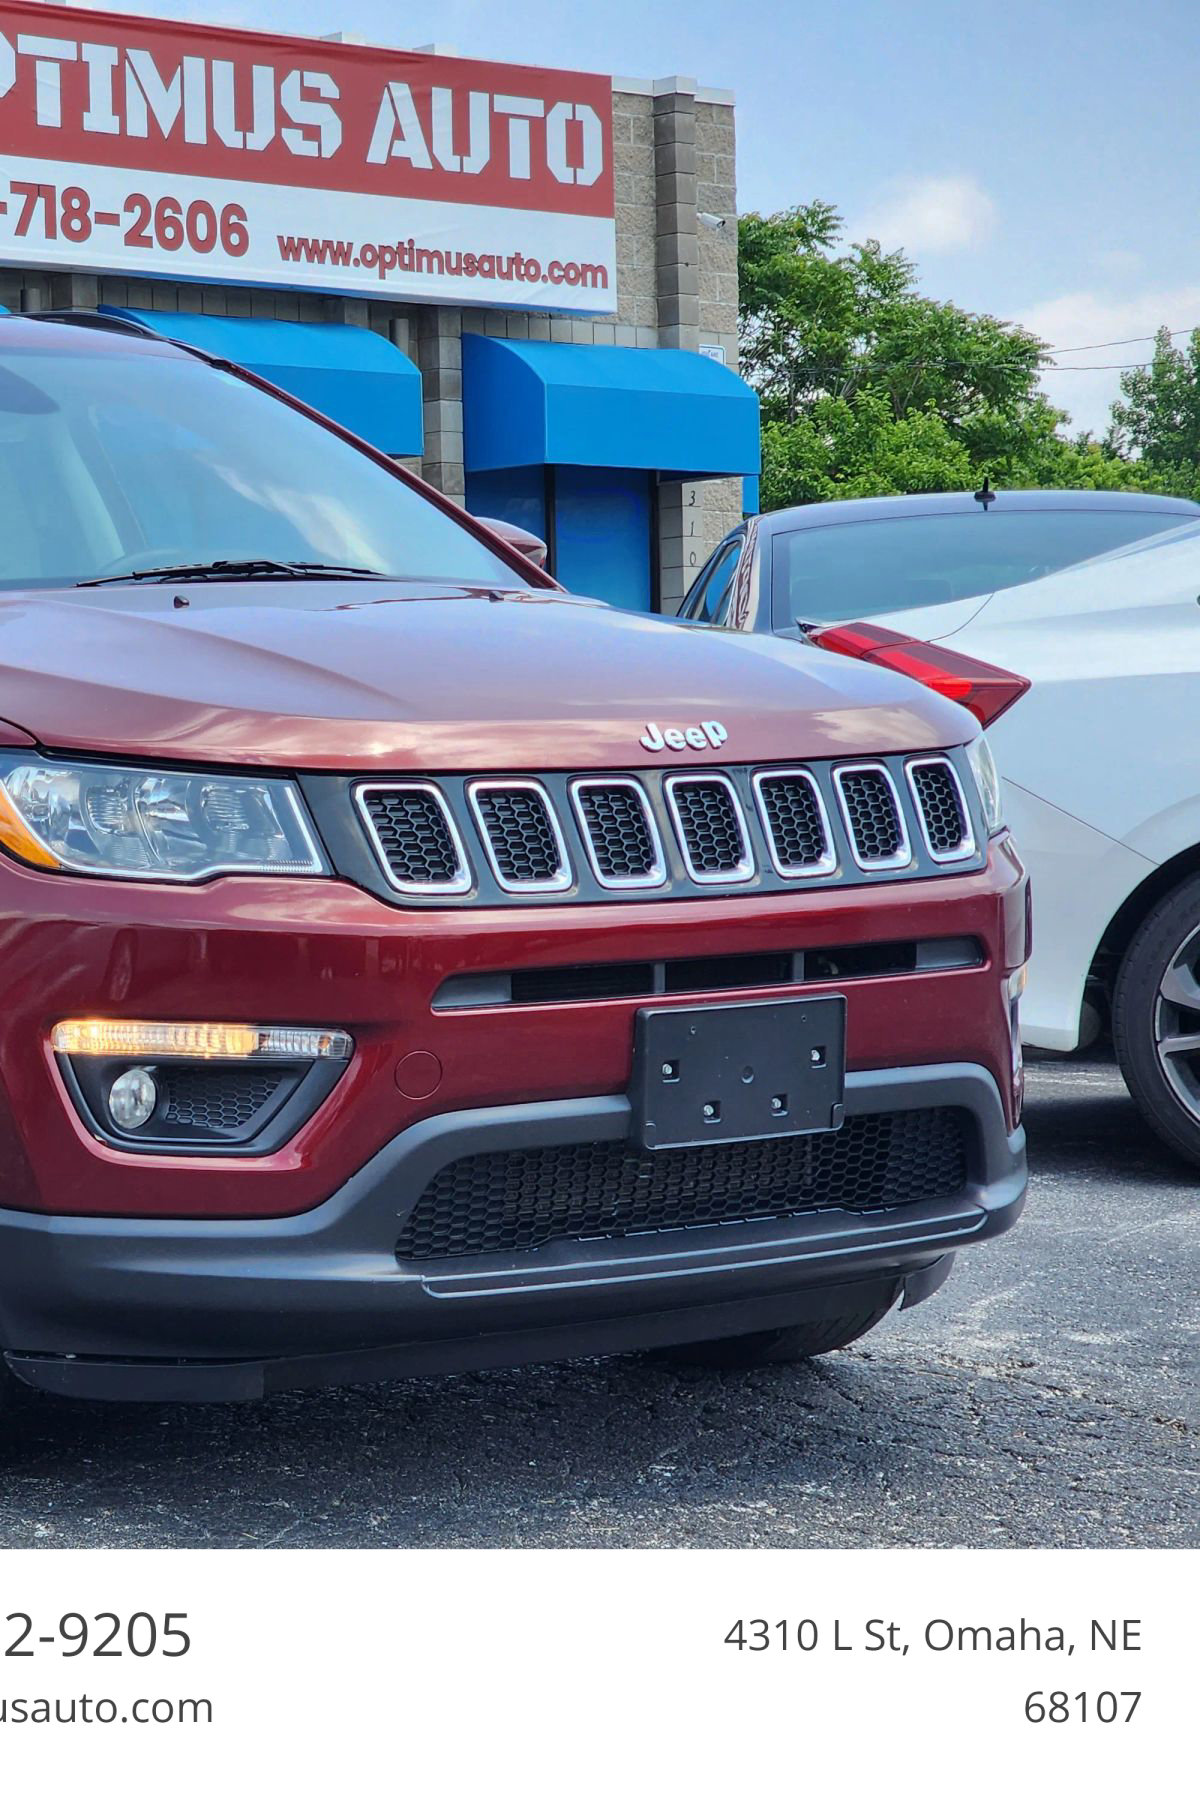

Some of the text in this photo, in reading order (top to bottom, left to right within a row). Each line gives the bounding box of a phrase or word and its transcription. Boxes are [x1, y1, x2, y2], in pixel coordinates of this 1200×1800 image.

[365, 81, 603, 186] AUTO
[277, 235, 608, 289] www.optimusauto.com
[639, 720, 728, 753] Jeep
